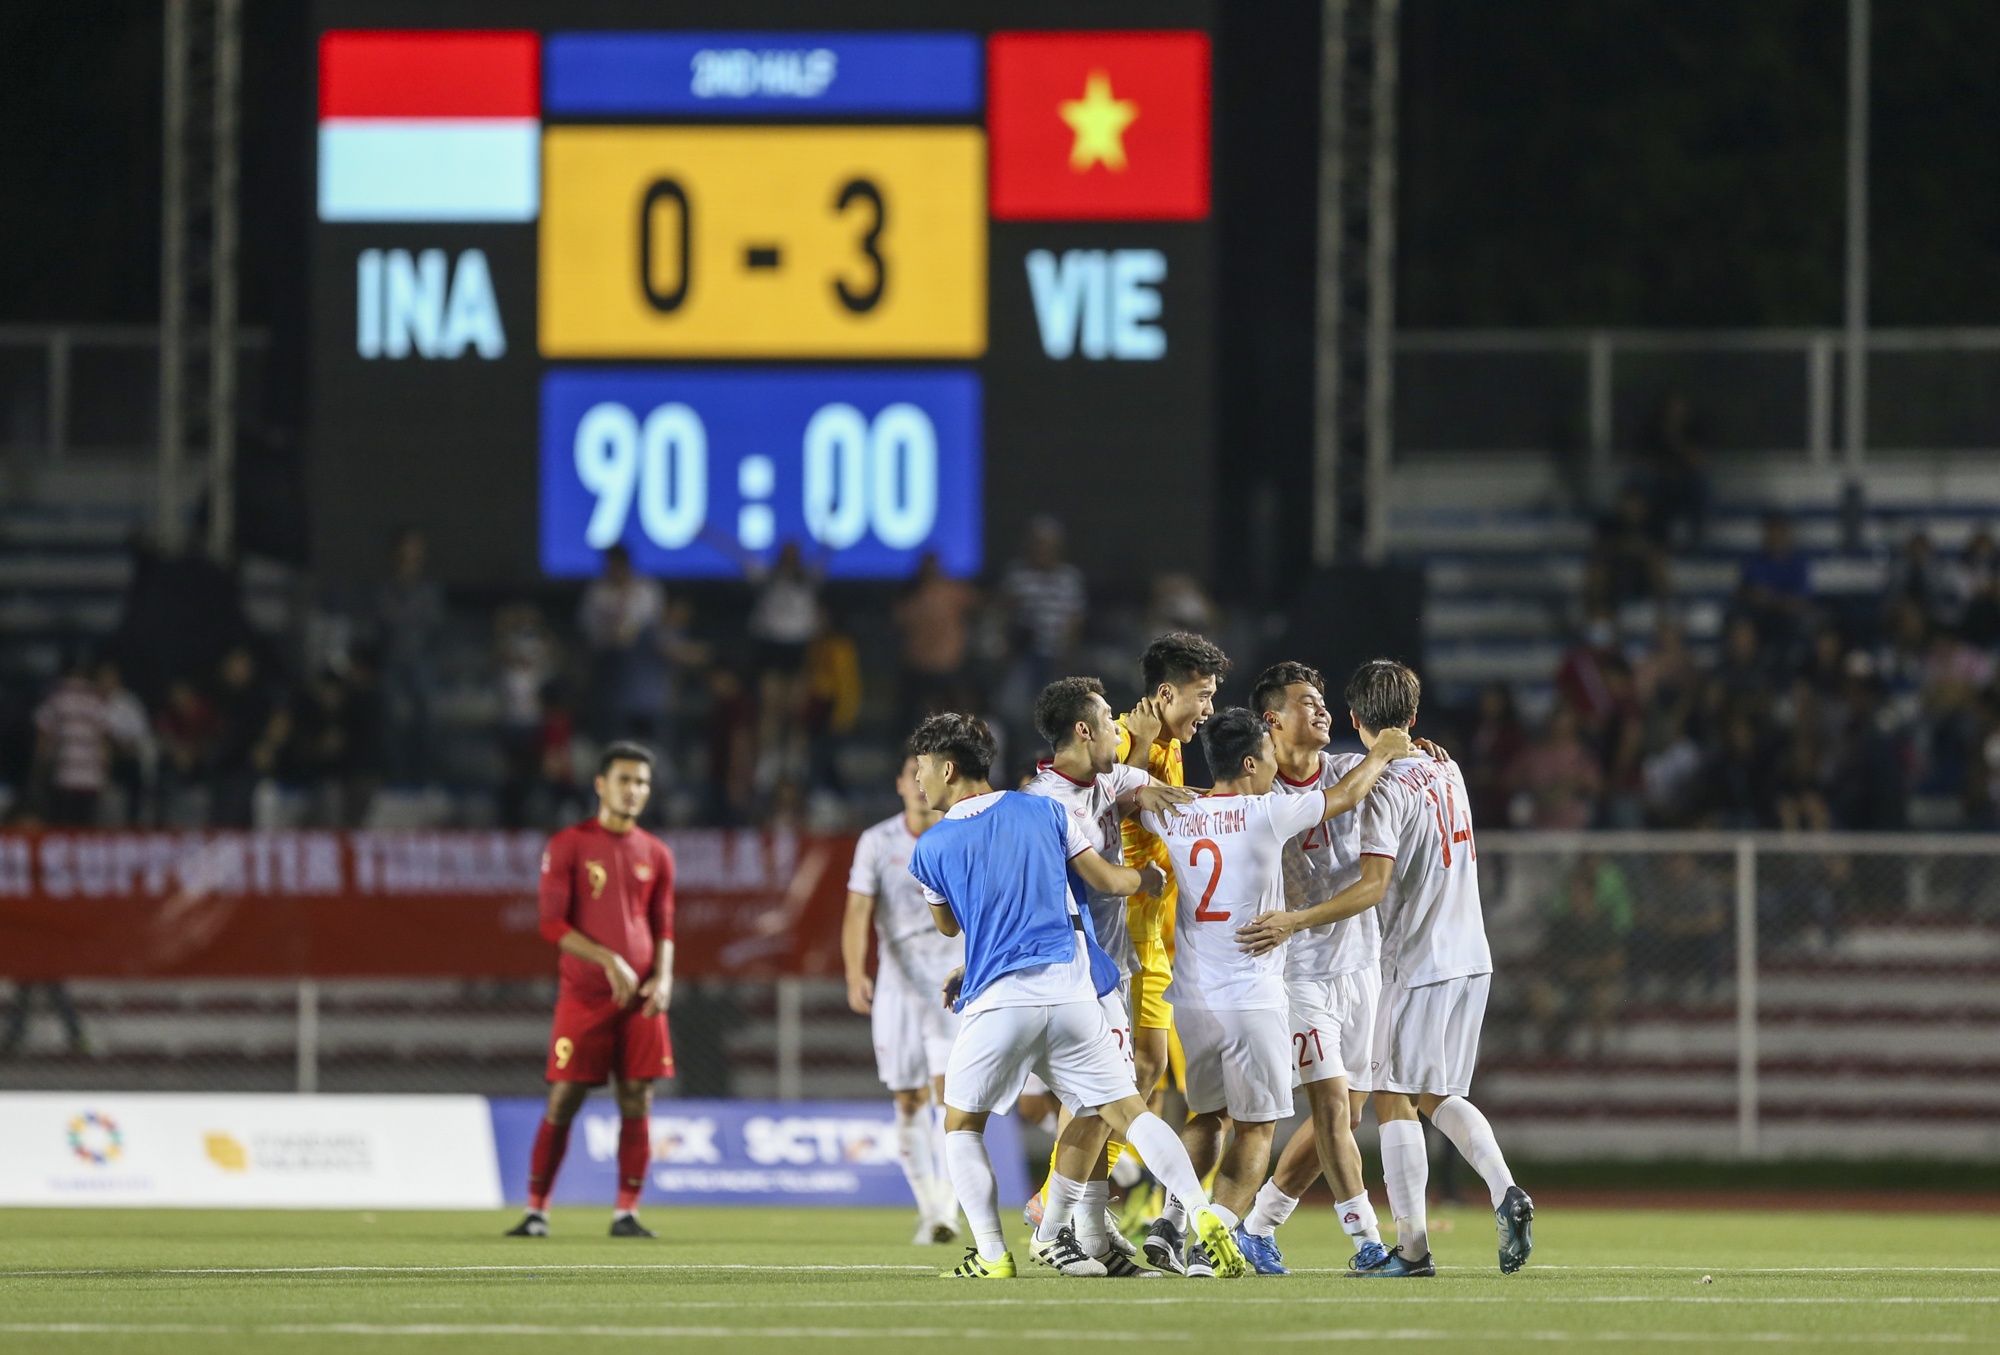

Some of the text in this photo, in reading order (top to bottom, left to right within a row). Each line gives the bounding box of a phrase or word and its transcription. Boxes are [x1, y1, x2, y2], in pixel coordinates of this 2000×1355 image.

[637, 175, 693, 316] 0
[830, 175, 889, 316] 3
[356, 248, 507, 360] INA
[1025, 248, 1168, 360] VIE
[1098, 810, 1118, 851] 23
[1178, 811, 1209, 837] THANH
[1425, 782, 1476, 869] 14
[585, 860, 608, 900] 9
[1190, 838, 1230, 922] 2
[555, 1036, 574, 1070] 9
[1293, 1028, 1324, 1067] 21
